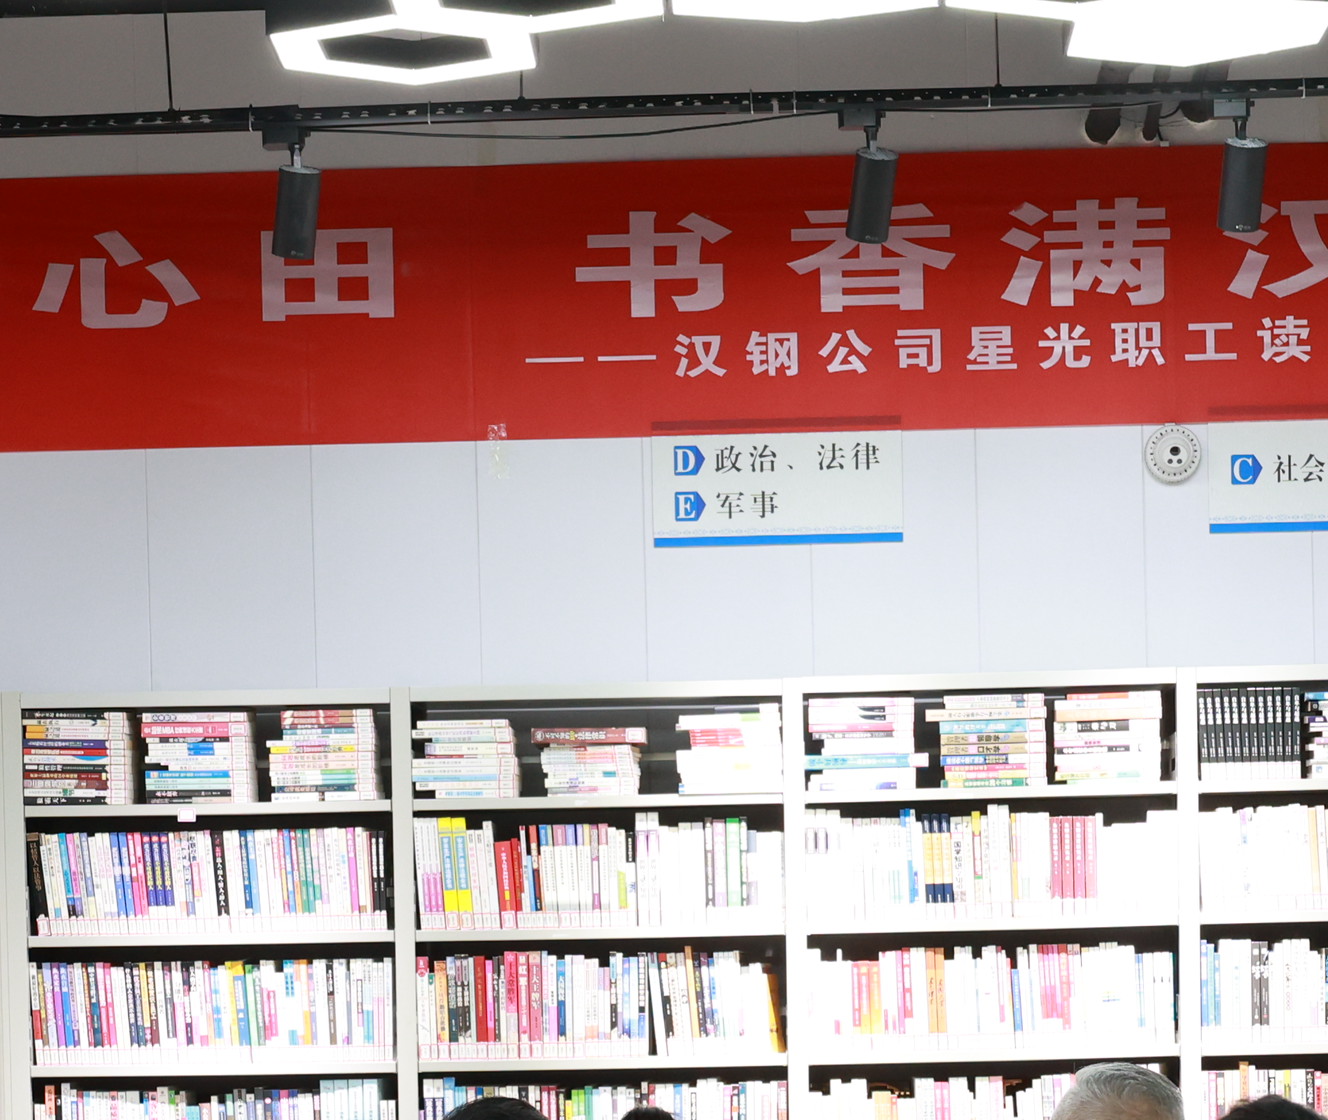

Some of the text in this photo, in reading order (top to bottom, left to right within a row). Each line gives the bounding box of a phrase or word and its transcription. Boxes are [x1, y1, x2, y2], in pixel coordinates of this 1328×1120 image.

[675, 442, 880, 474] D 政治、法律
[1233, 457, 1253, 483] C
[676, 491, 778, 519] E 军事
